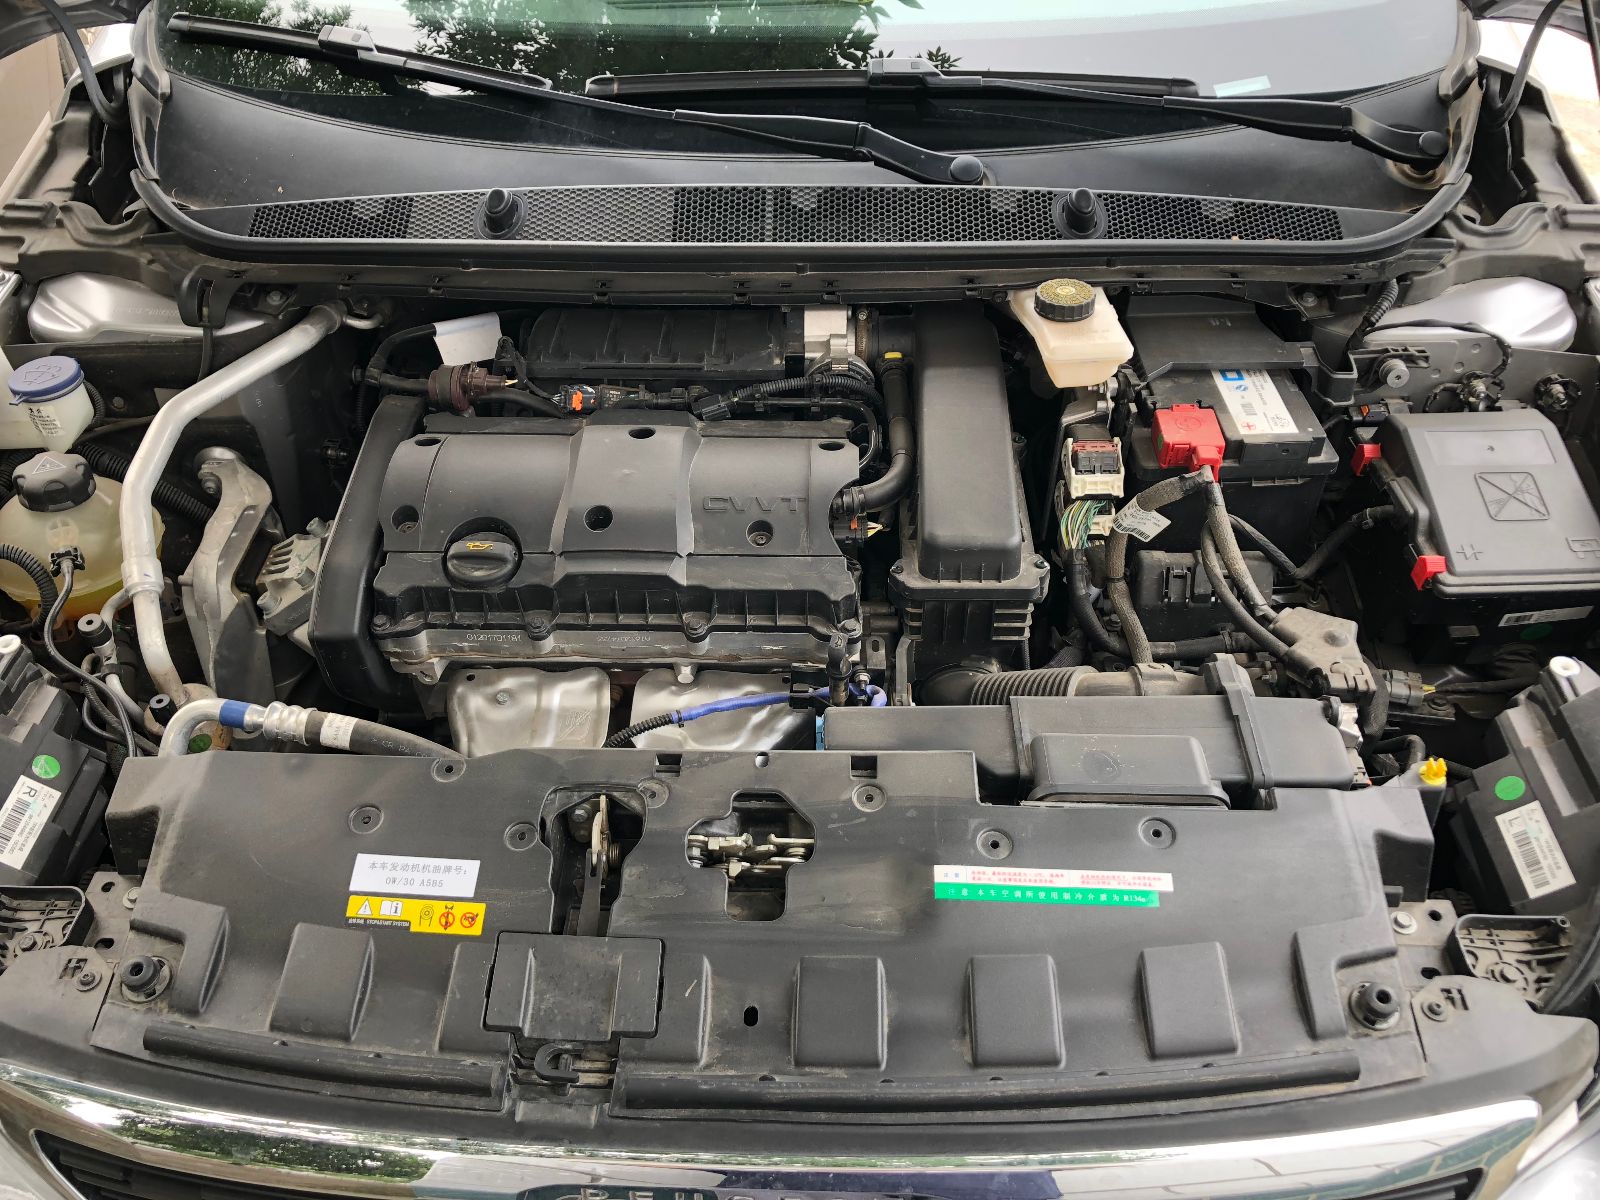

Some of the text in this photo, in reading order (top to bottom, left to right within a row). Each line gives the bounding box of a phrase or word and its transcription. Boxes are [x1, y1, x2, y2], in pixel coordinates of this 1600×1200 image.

[703, 495, 807, 513] CVVT
[23, 786, 37, 798] R
[385, 876, 444, 888] 0W/30 A5B5
